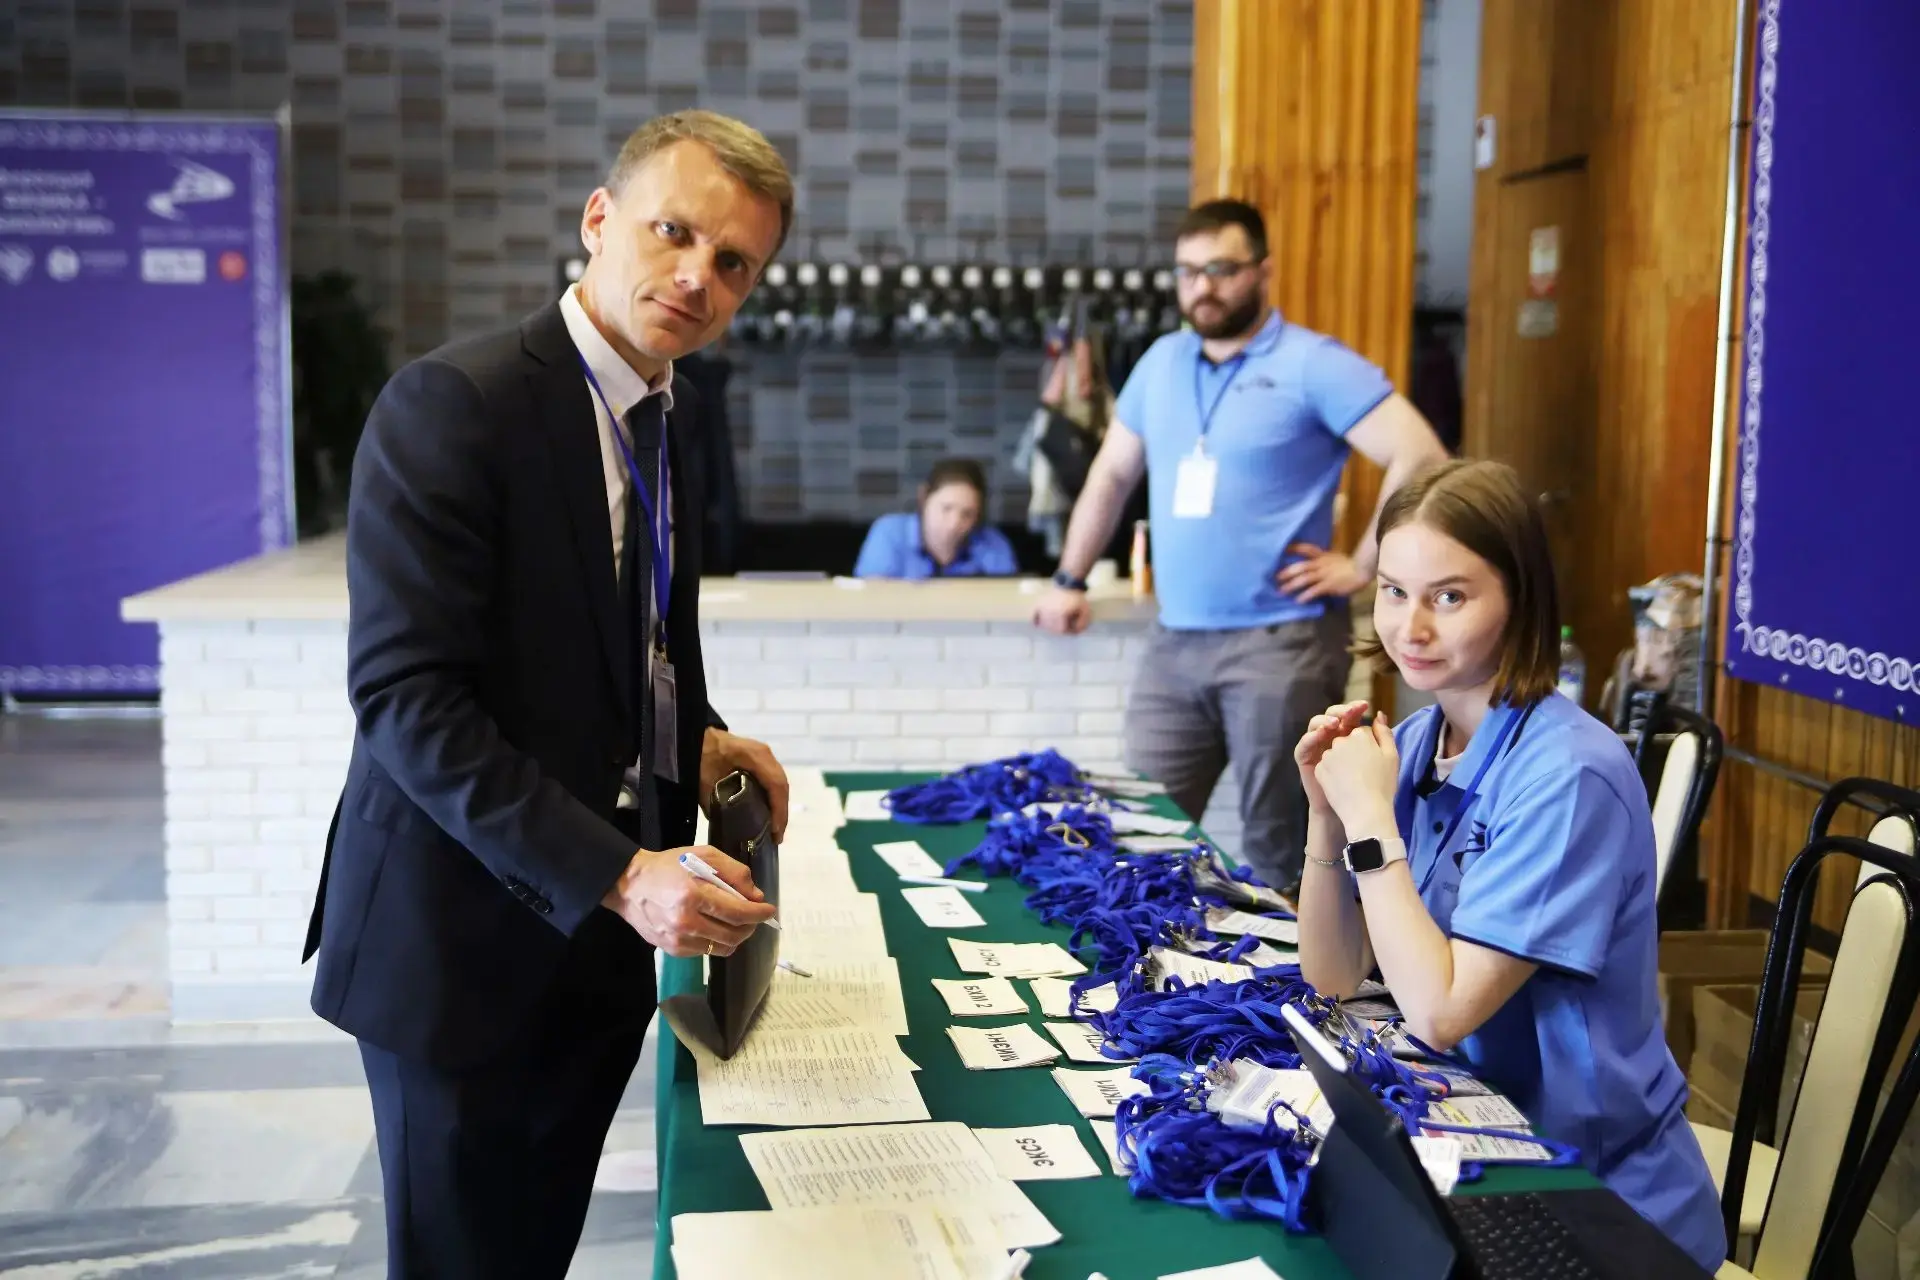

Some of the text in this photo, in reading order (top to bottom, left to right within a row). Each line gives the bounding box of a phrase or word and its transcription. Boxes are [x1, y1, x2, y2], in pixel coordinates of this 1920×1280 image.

[963, 985, 989, 1002] БХМ
[985, 1033, 1020, 1061] МИЭН1
[1015, 1138, 1055, 1167] ЭКС5
